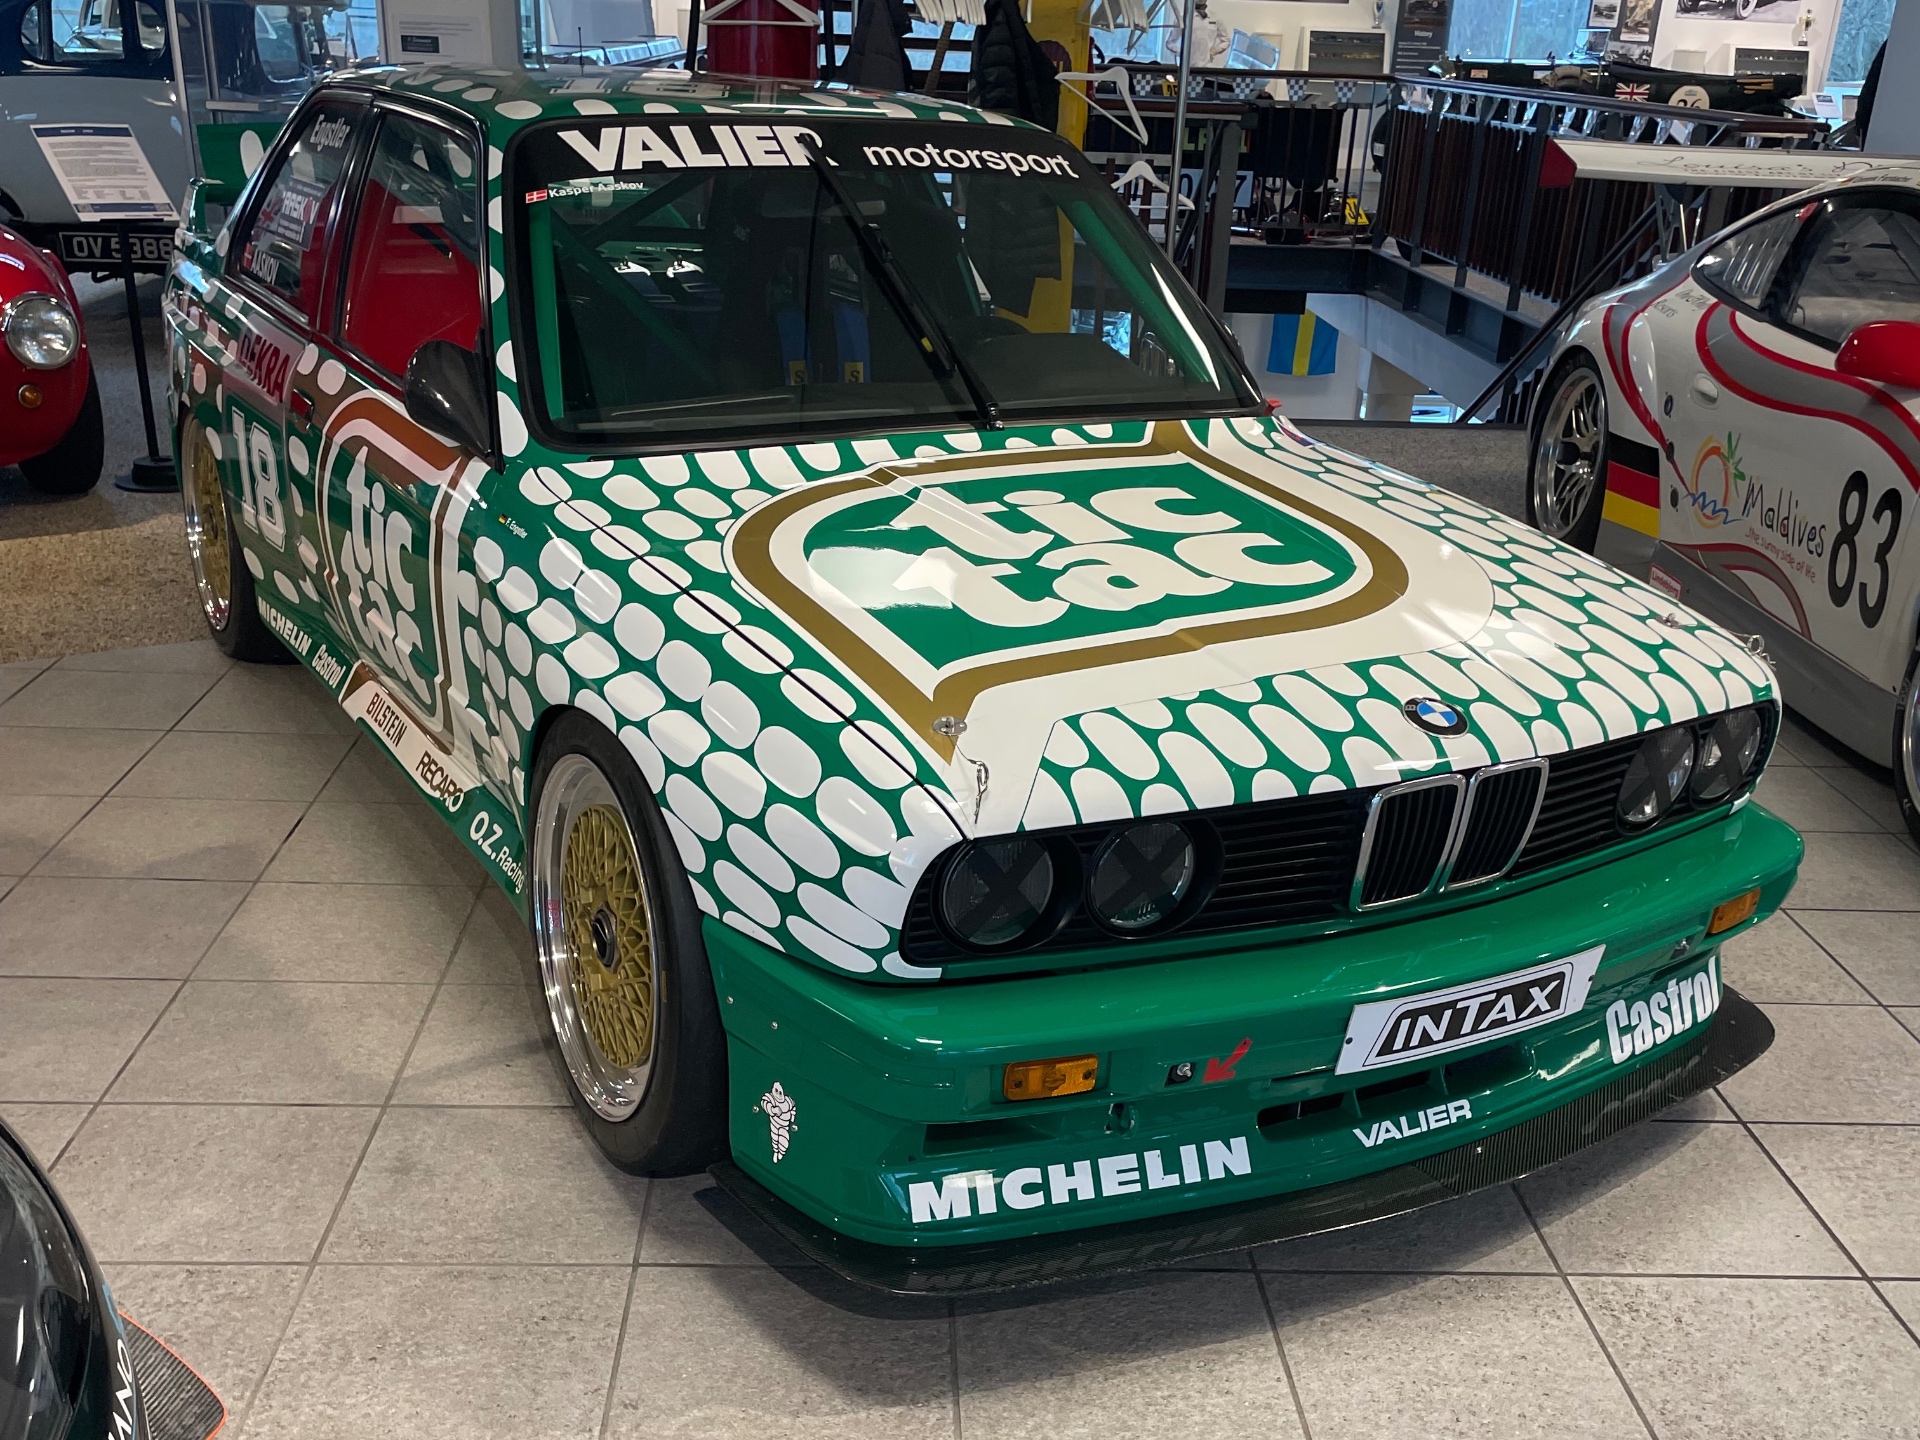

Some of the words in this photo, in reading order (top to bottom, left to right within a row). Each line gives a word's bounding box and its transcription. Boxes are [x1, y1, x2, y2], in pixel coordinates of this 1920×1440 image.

[310, 114, 351, 152] Engstler
[557, 125, 840, 172] VALIER
[862, 143, 1080, 179] motorsport
[549, 183, 594, 199] Kasper
[597, 180, 645, 193] Aaskov
[73, 236, 102, 258] OV
[250, 249, 280, 285] AASKOV
[231, 405, 287, 553] 18
[346, 445, 416, 612] tic
[889, 487, 1242, 560] tic
[1741, 475, 1827, 558] Maldives
[892, 532, 1335, 628] tac
[1828, 470, 1903, 629] 83
[258, 596, 313, 657] MICHELIN
[340, 530, 434, 705] tac
[311, 644, 346, 689] Castrol
[366, 692, 408, 748] BILSTEIN
[415, 750, 464, 813] RECARO
[495, 845, 525, 894] Racing
[1392, 978, 1561, 1052] INTAX
[1605, 955, 1721, 1066] Castrol
[1352, 1099, 1473, 1148] VALIER
[908, 1136, 1252, 1224] MICHELIN
